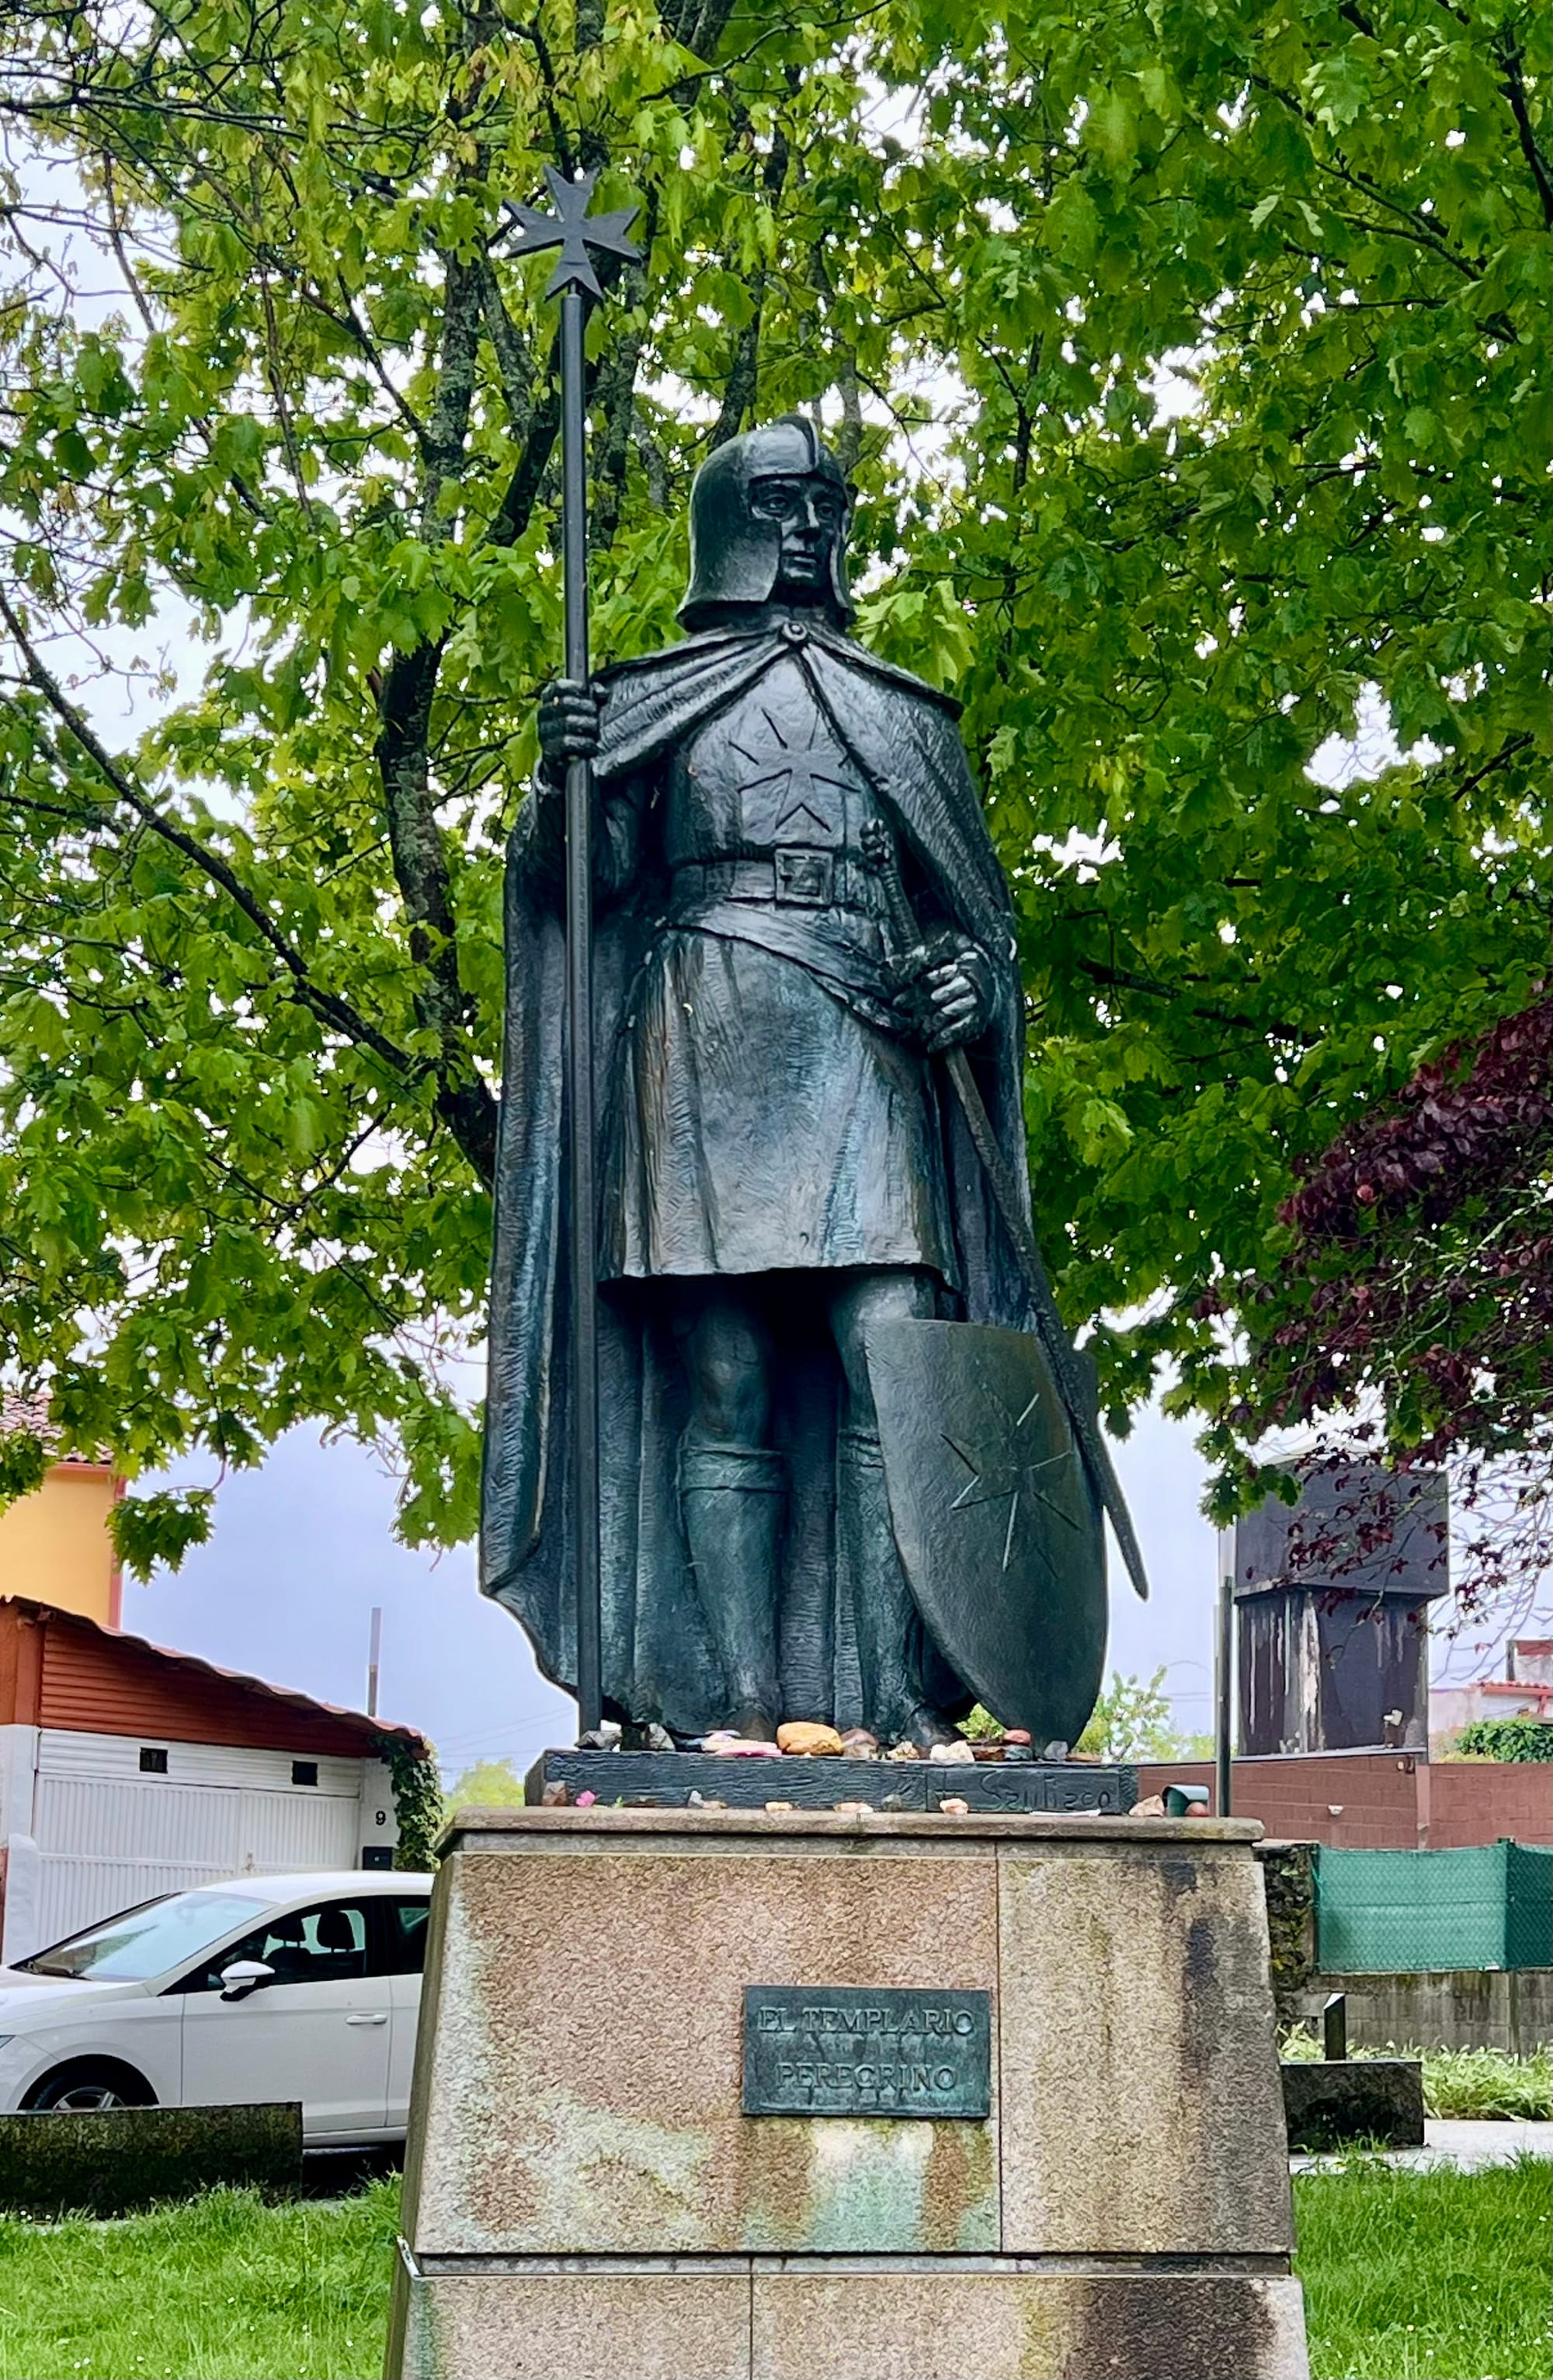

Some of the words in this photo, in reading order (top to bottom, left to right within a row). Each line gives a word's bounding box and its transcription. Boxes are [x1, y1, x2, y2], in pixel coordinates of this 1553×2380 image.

[375, 1810, 387, 1826] 9
[758, 2006, 797, 2034] EL
[801, 2006, 975, 2036] TEMPLARIO
[776, 2062, 959, 2092] PEREGRINO
